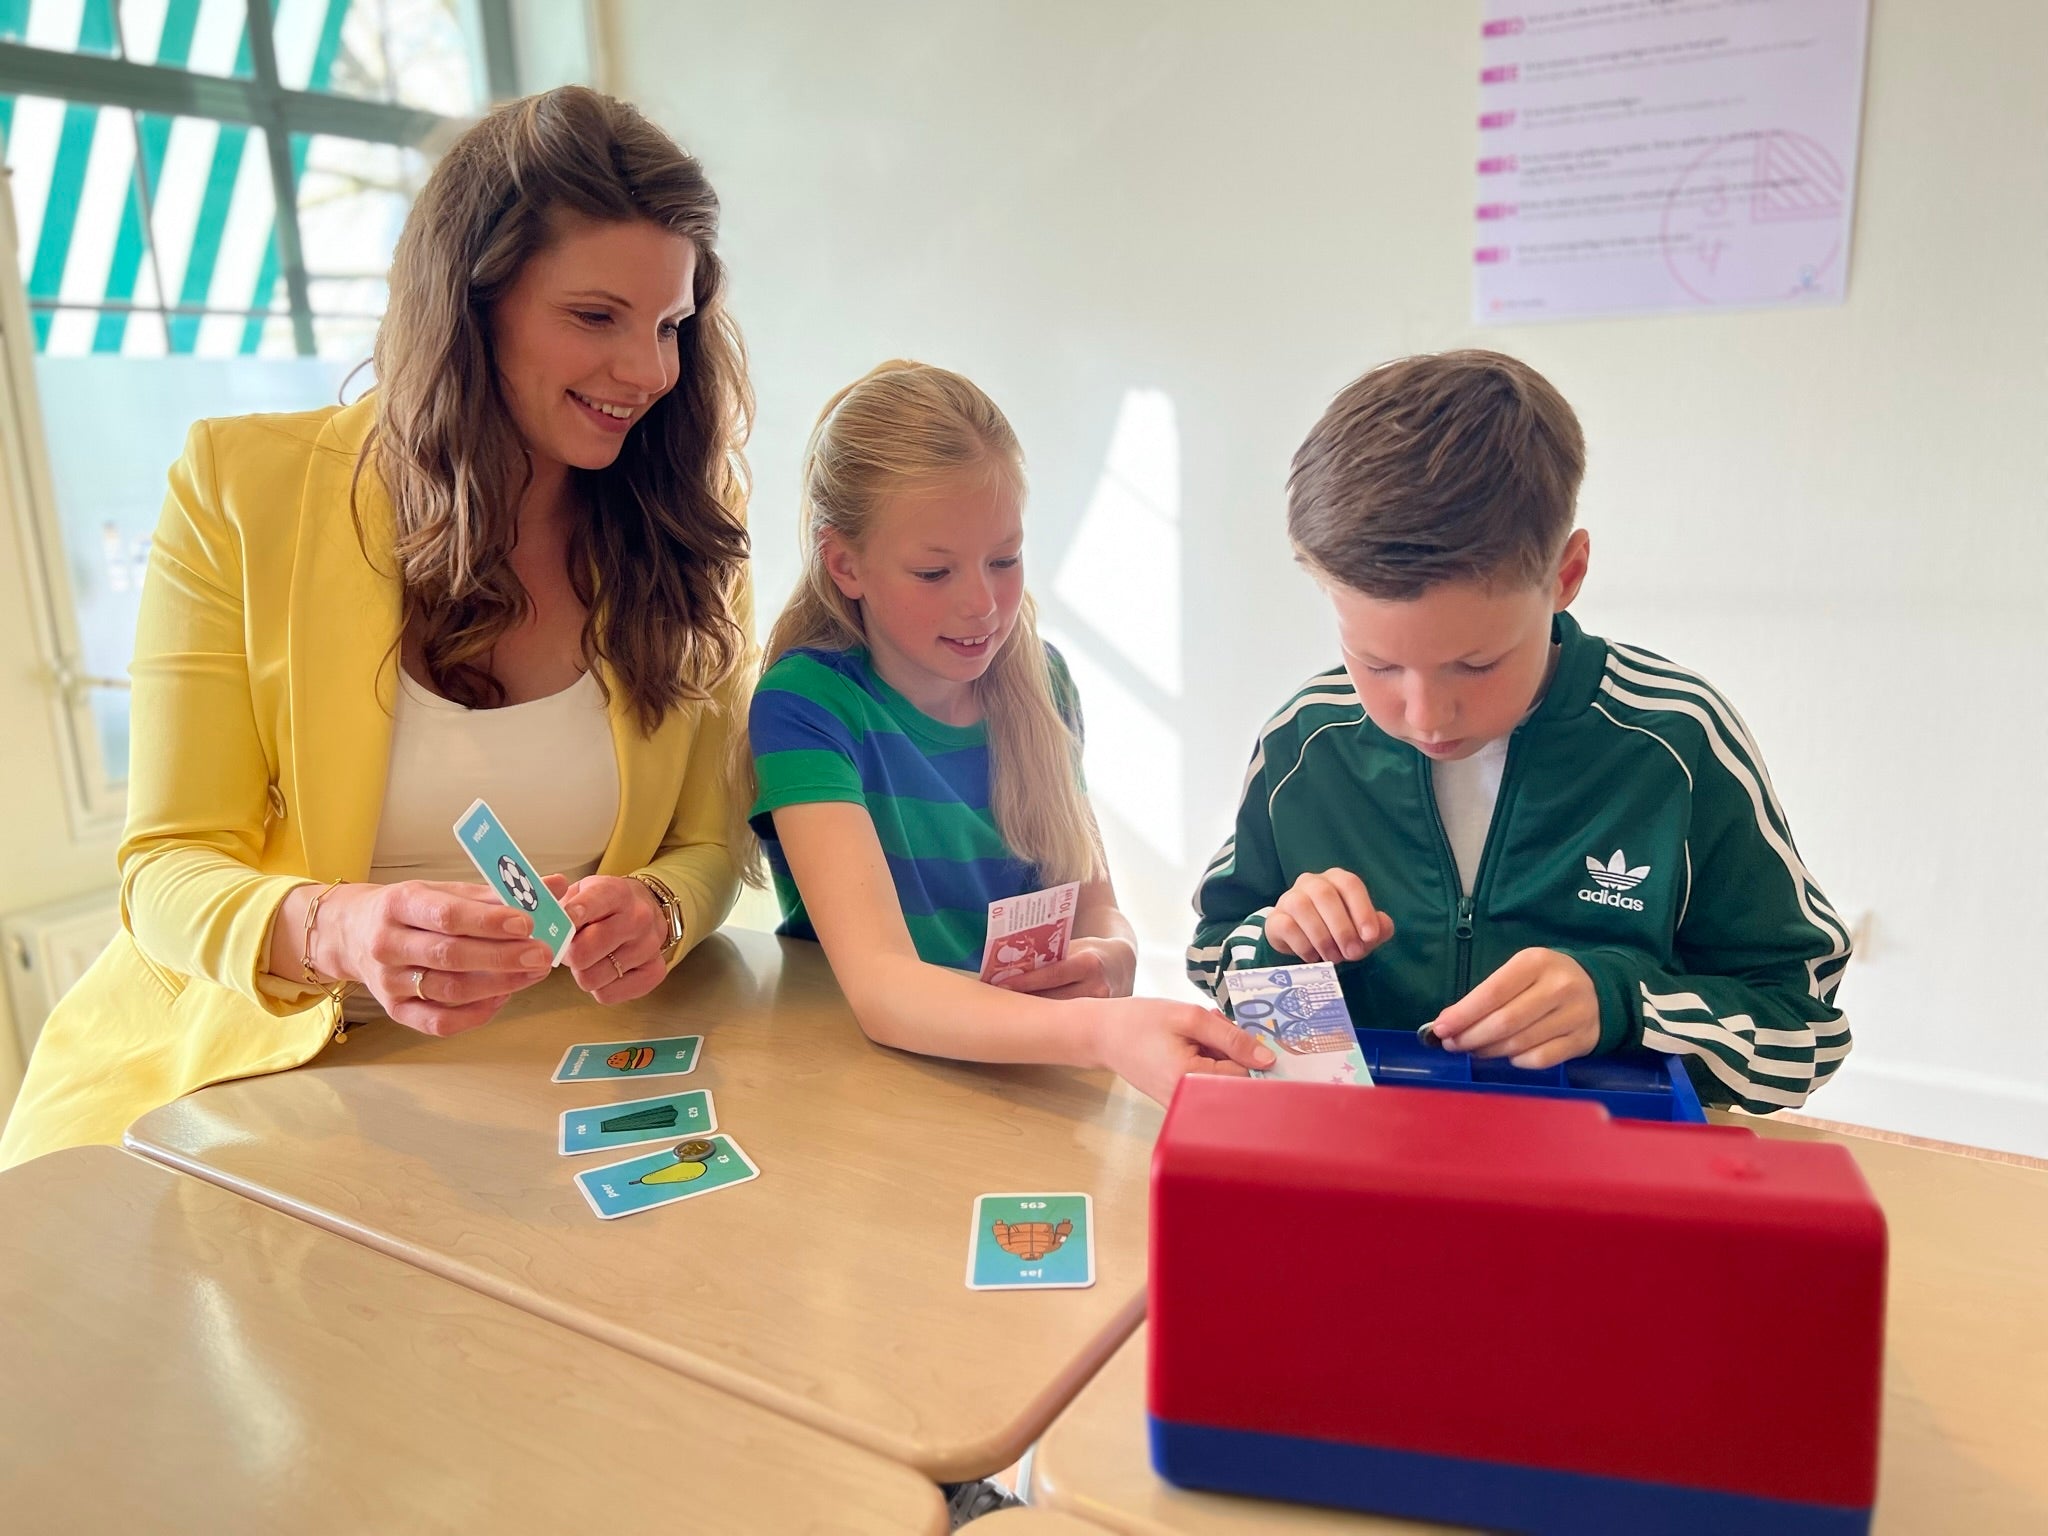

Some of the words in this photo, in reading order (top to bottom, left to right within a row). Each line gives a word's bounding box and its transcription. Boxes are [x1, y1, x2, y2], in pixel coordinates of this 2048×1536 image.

[1577, 889, 1644, 911] adidas
[992, 906, 1004, 919] 10
[1059, 902, 1071, 914] 10
[1274, 973, 1287, 985] 20
[1321, 970, 1332, 979] 20
[568, 1049, 590, 1076] hamburger
[575, 1123, 587, 1135] rok
[716, 1154, 730, 1164] €2
[601, 1183, 620, 1198] peer
[1020, 1202, 1047, 1210] €95
[1020, 1268, 1042, 1278] jas
